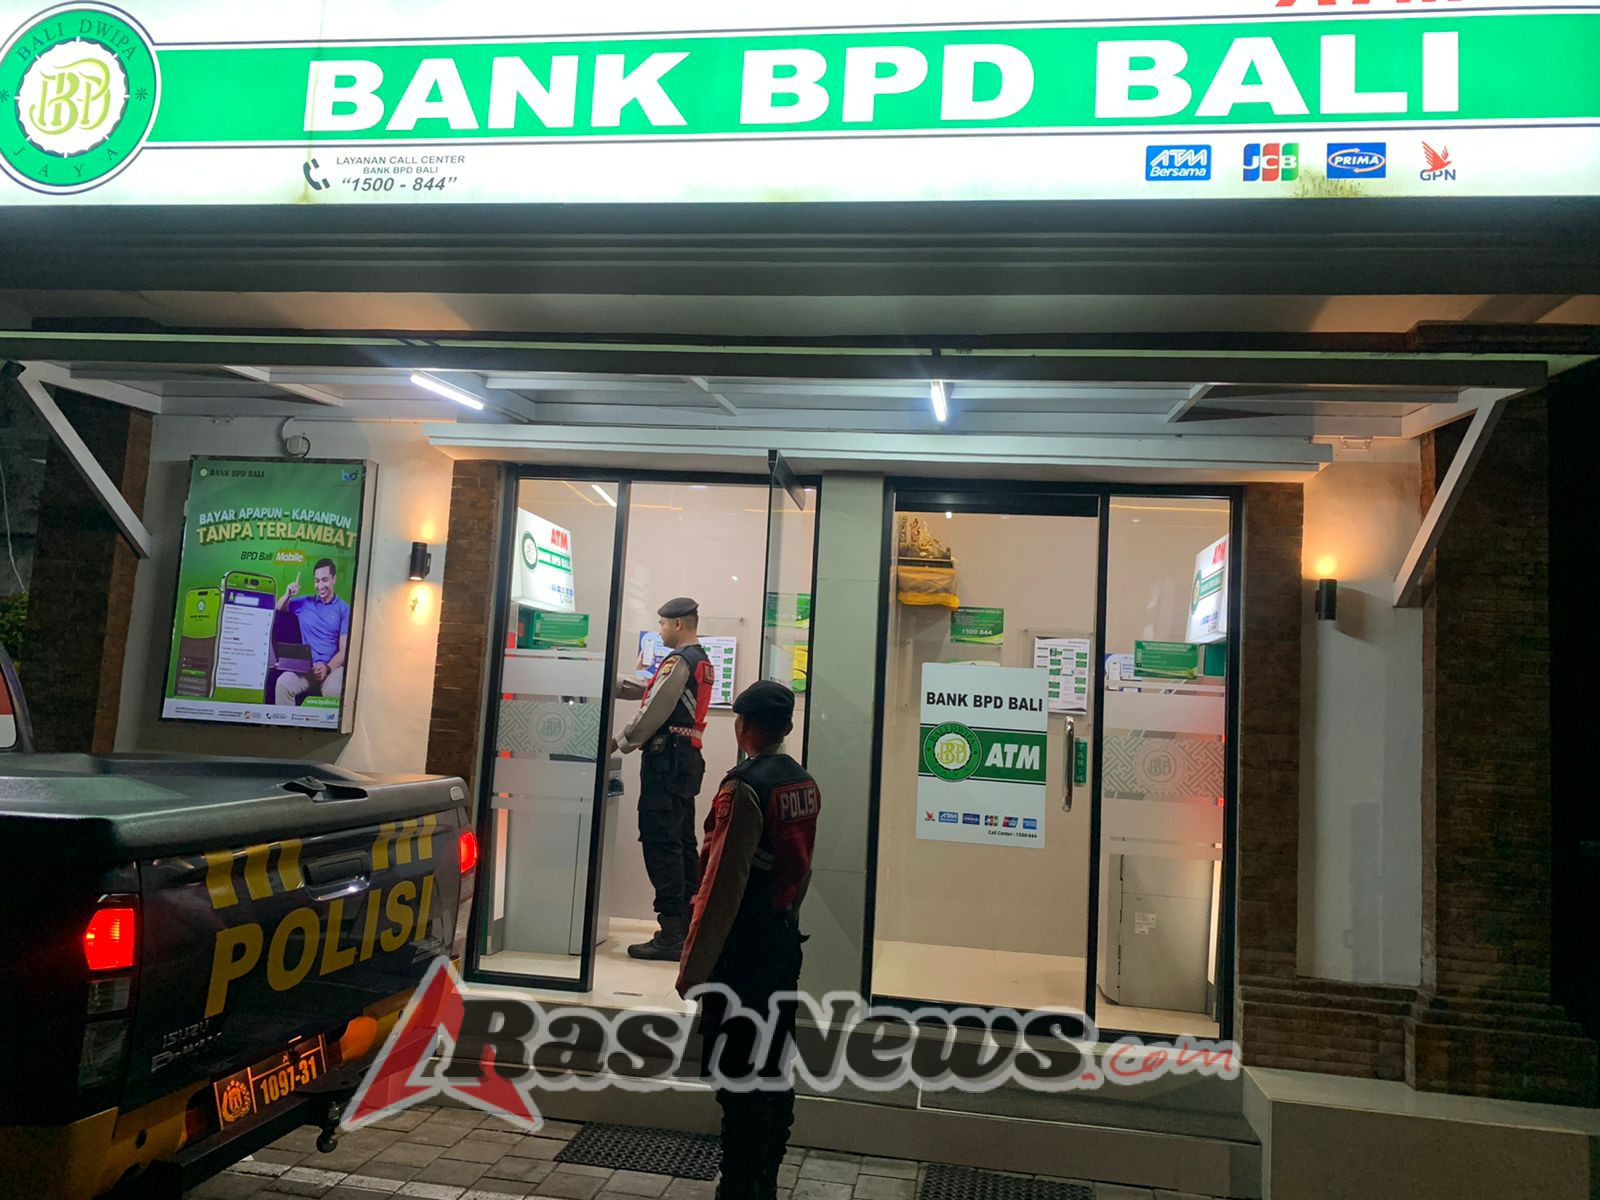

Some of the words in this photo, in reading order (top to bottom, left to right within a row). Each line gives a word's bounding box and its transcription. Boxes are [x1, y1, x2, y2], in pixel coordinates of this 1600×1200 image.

[16, 22, 65, 62] BALI
[79, 18, 137, 61] DWIPA
[303, 51, 690, 132] BANK
[739, 43, 1036, 126] BPD
[1095, 31, 1460, 120] BALI
[13, 146, 119, 178] JAYA
[336, 156, 387, 165] LAYANAN
[389, 155, 418, 165] CALL
[420, 155, 465, 164] CENTER
[1150, 148, 1208, 167] ATM
[1334, 156, 1380, 166] PRIMA
[362, 166, 390, 174] BANK
[392, 166, 413, 174] BPD
[415, 166, 439, 174] BALI
[1150, 166, 1207, 177] Bersama
[1420, 168, 1456, 181] GPN
[209, 469, 230, 477] BANK
[232, 470, 247, 478] BPD
[248, 470, 265, 478] BALI
[199, 509, 236, 525] BAYAR
[239, 507, 283, 520] APAPUN
[291, 508, 352, 528] KAPANPUN
[197, 522, 253, 544] TANPA
[257, 521, 357, 548] TERLAMBAT
[551, 528, 568, 550] ATM
[240, 552, 258, 561] BPD
[258, 552, 273, 561] Bali
[275, 551, 304, 562] Mobile
[926, 691, 968, 707] BANK
[973, 694, 1003, 709] BPD
[1008, 697, 1043, 712] BALI
[984, 742, 1040, 770] ATM
[780, 787, 819, 821] POLISI
[204, 875, 435, 1019] POLISI
[259, 1055, 317, 1105] 1097-31
